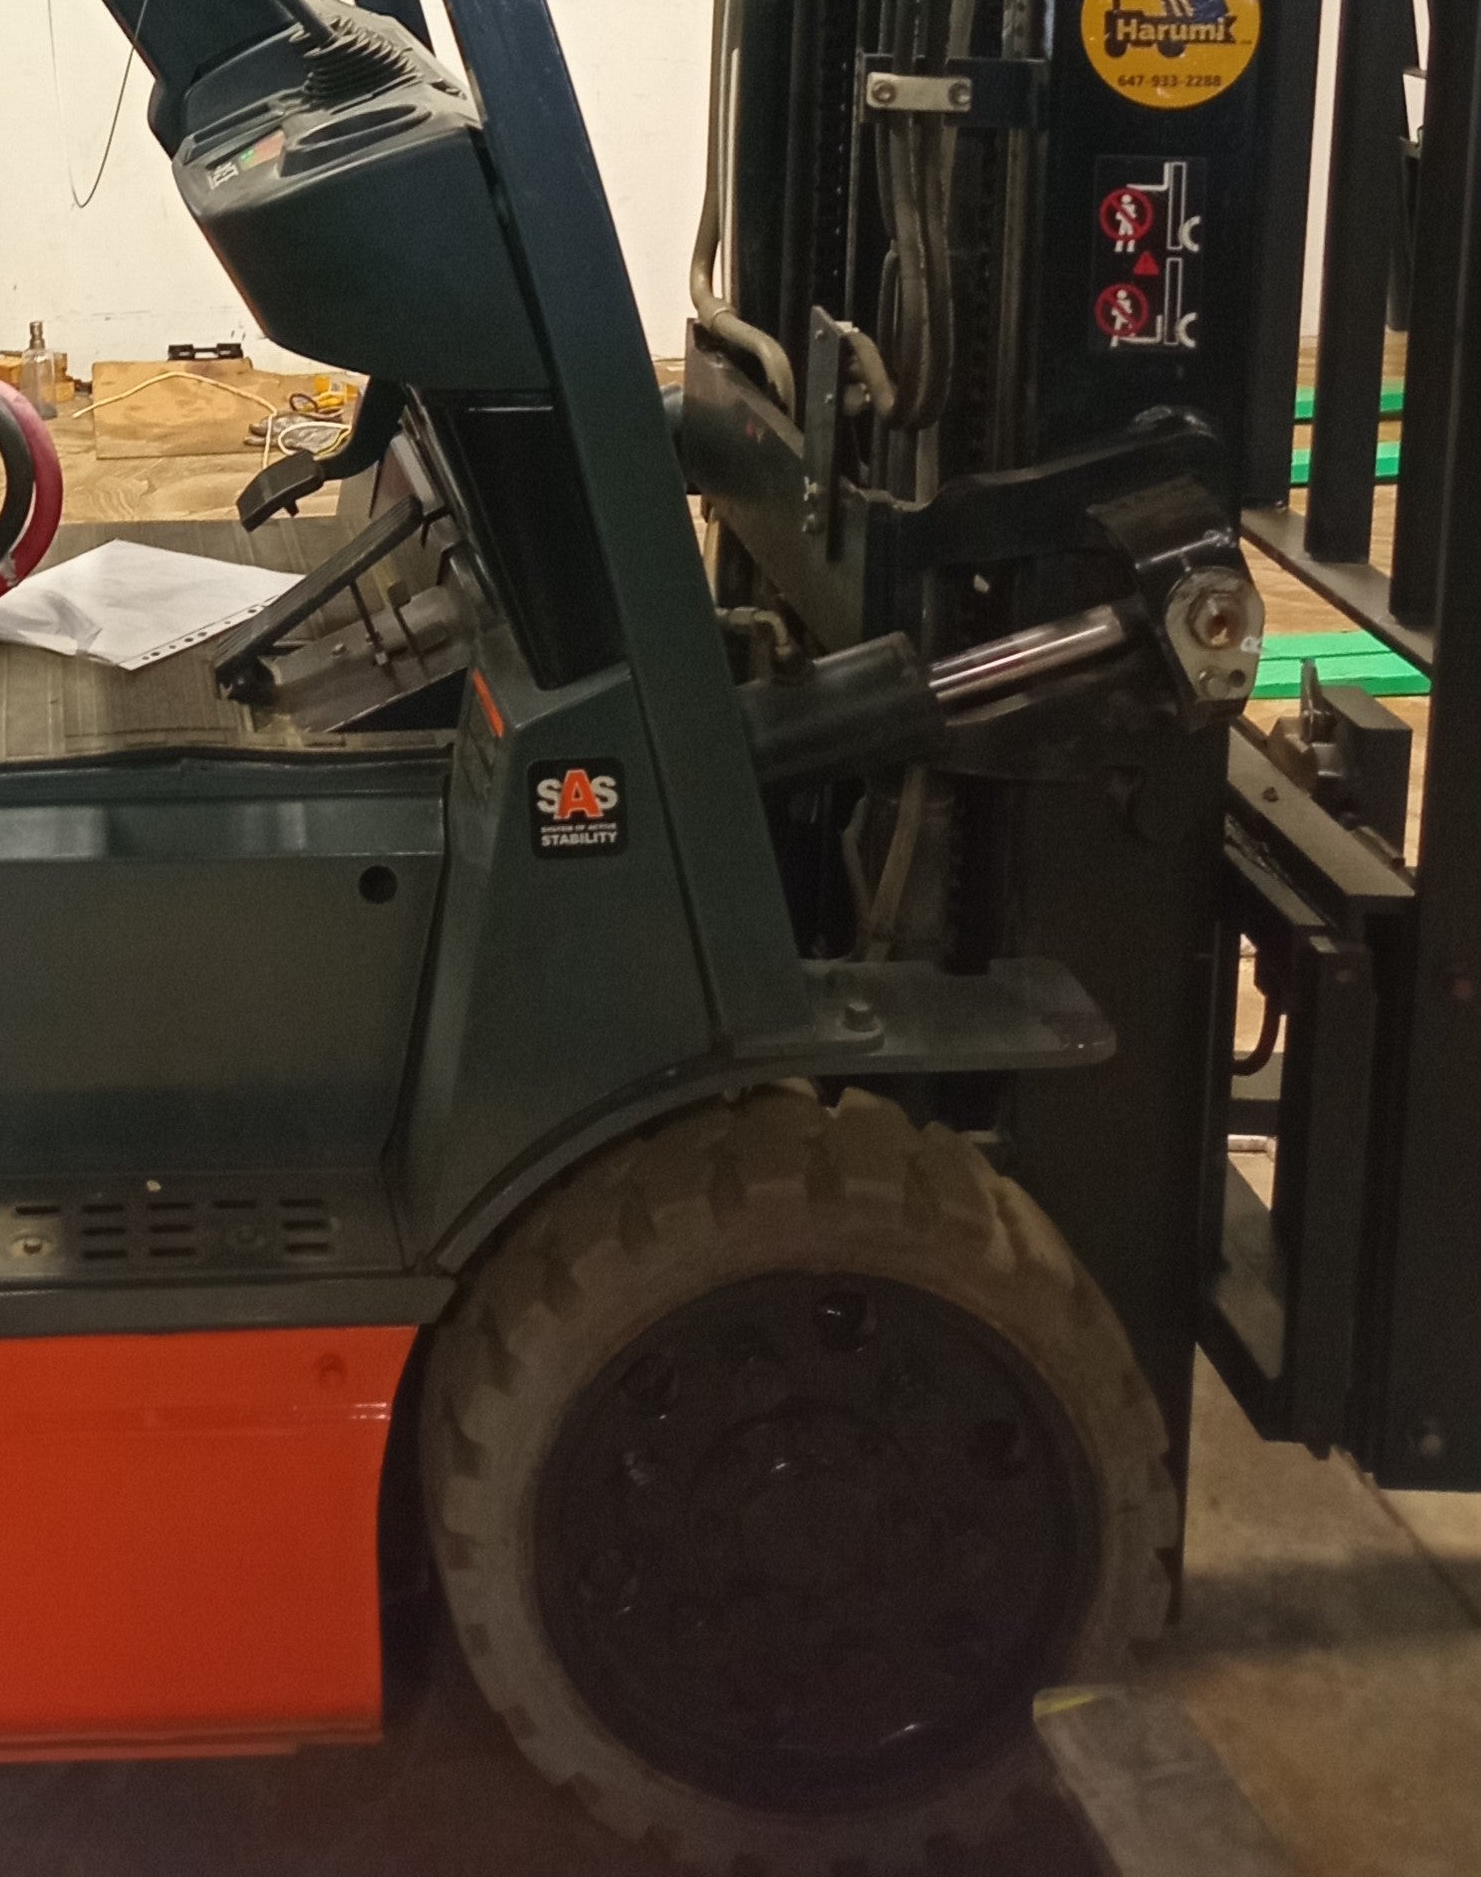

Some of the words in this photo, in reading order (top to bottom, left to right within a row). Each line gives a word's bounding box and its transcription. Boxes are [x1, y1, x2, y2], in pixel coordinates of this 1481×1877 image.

[1117, 17, 1226, 41] Harumi
[537, 768, 618, 820] SAS
[541, 830, 618, 846] STABILITY
